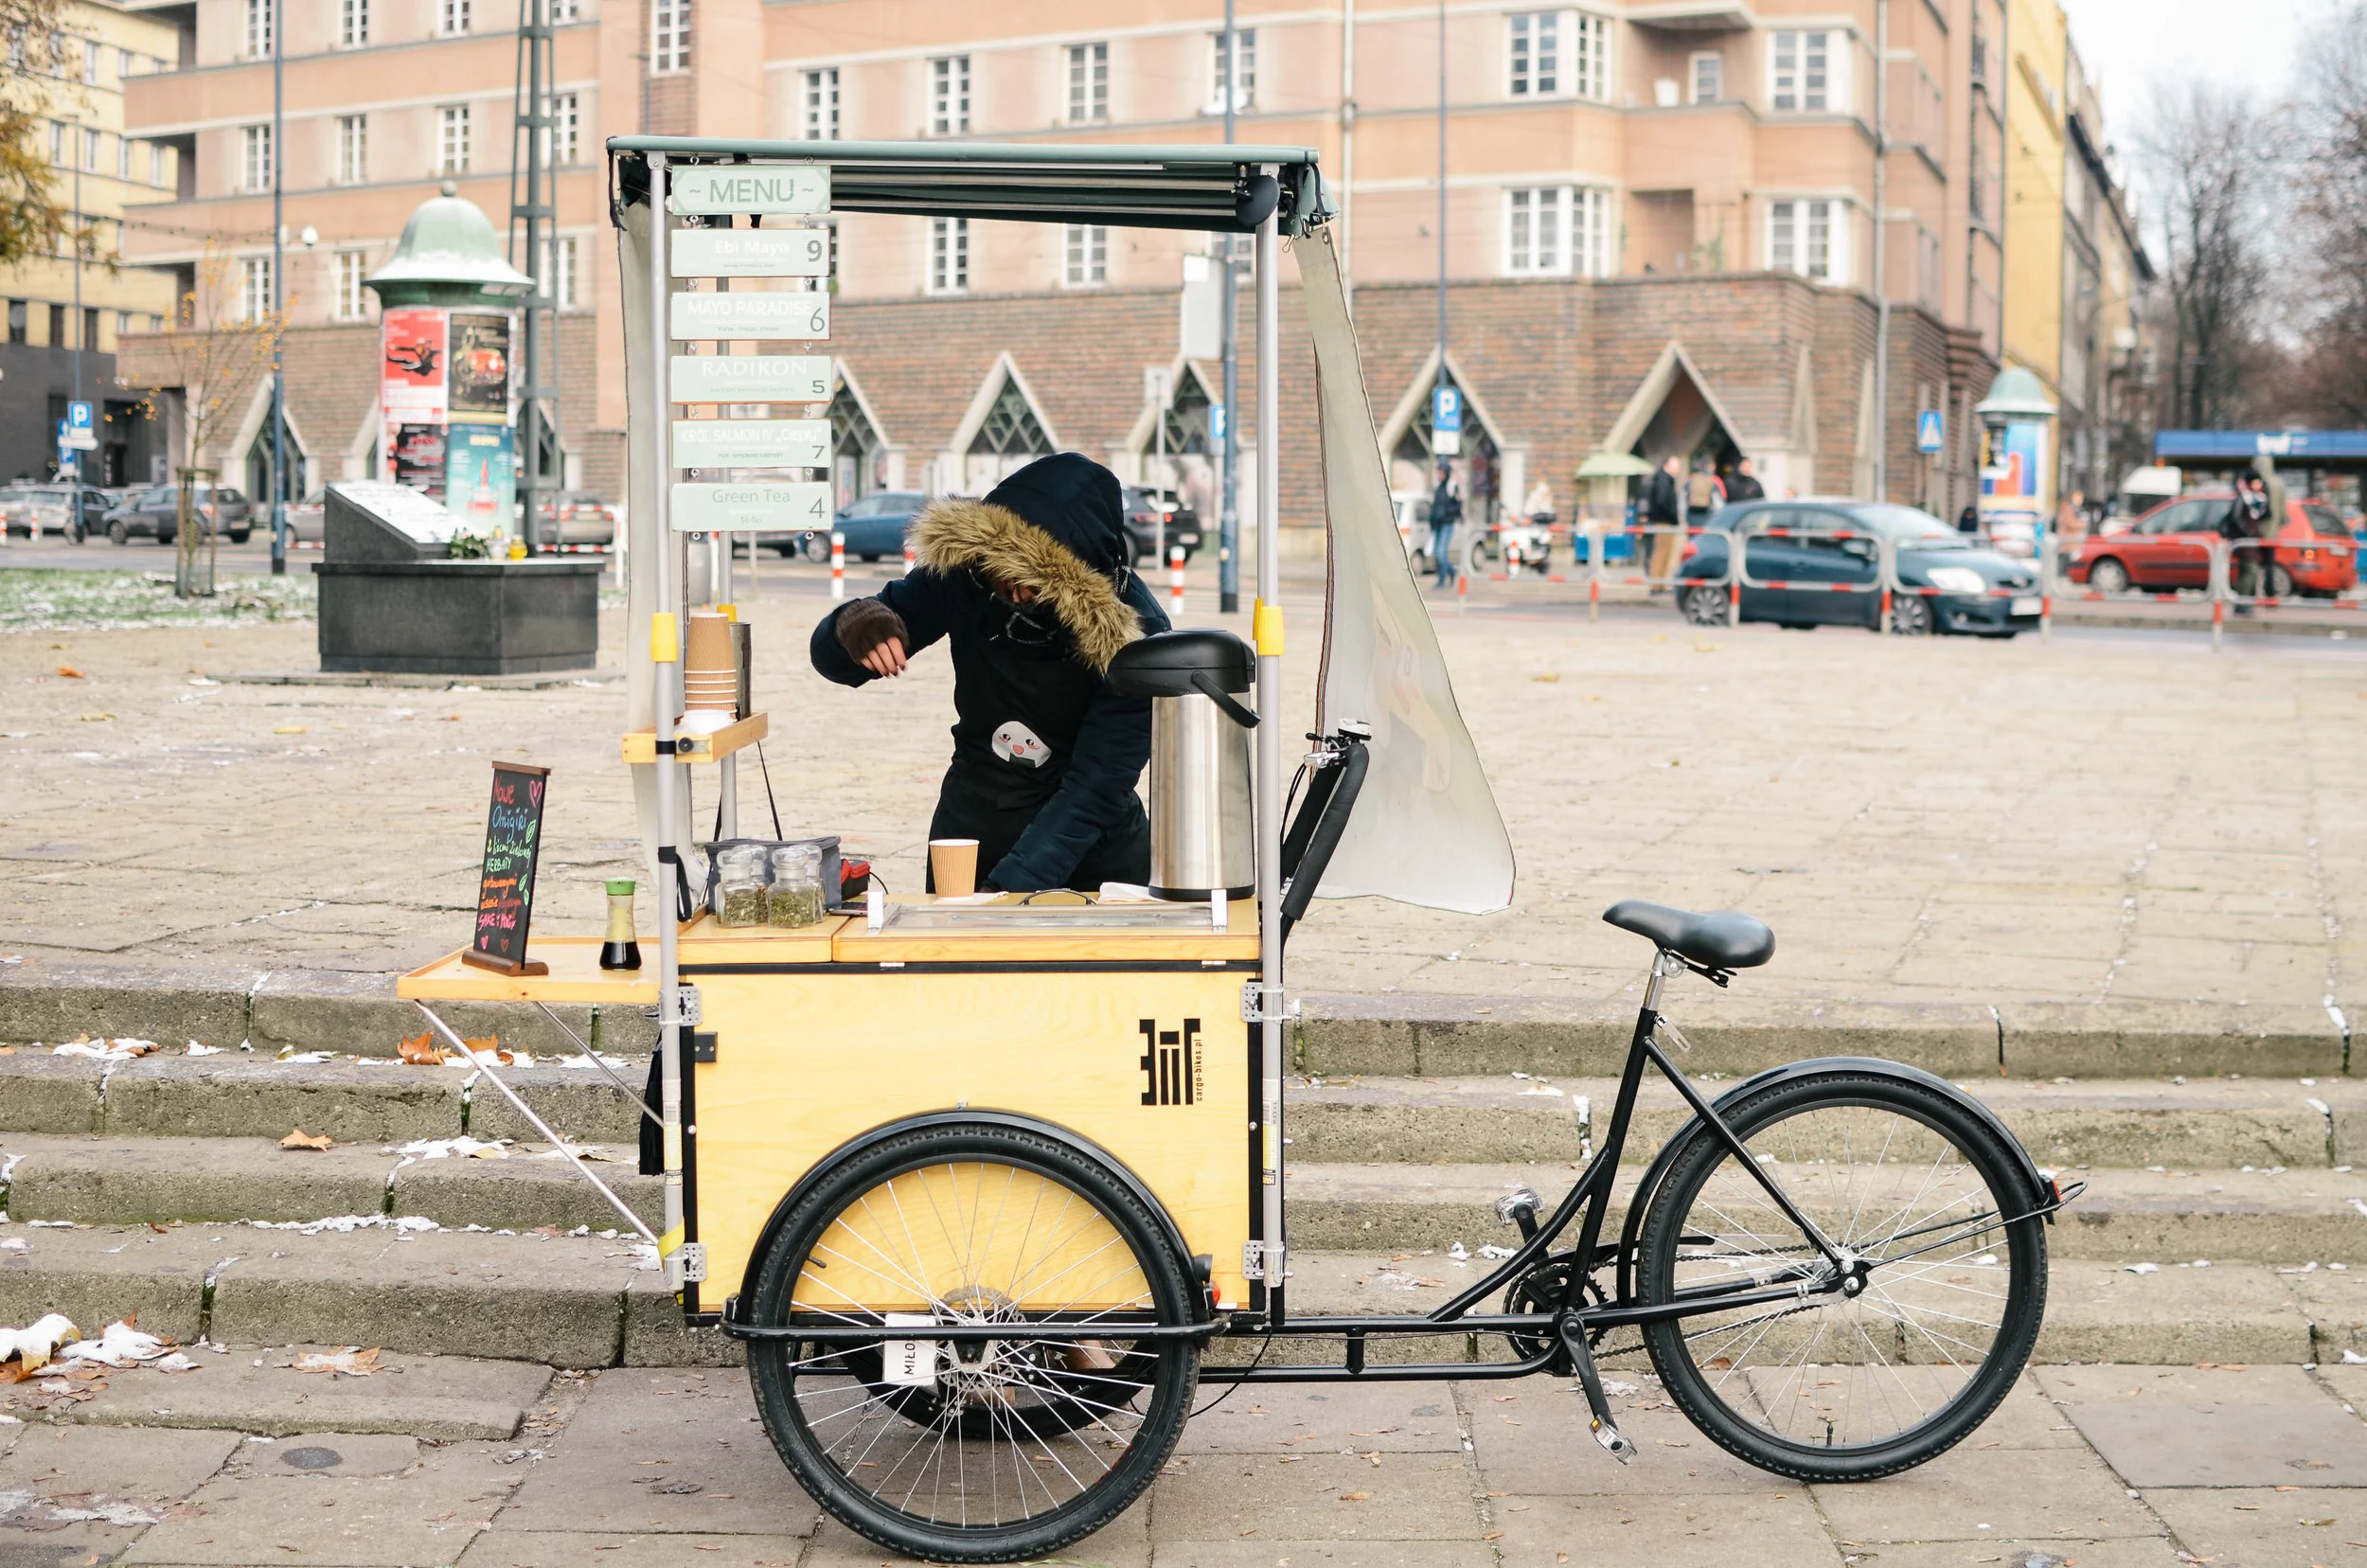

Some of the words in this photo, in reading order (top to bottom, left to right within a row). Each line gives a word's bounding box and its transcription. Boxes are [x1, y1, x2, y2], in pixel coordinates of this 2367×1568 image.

[710, 179, 794, 203] MENU
[715, 241, 739, 254] Ebi
[744, 241, 789, 258] Mayo
[807, 240, 823, 262] 9
[687, 300, 732, 315] MAYO
[737, 300, 812, 315] PARADISE
[810, 307, 826, 332] 6
[703, 361, 807, 377] RADIKON
[811, 380, 826, 394] 5
[74, 403, 88, 427] P
[1440, 389, 1456, 419] P
[713, 429, 760, 443] SALMON
[761, 429, 774, 442] IV
[811, 445, 826, 459] 7
[712, 489, 758, 503] Green
[763, 489, 791, 503] Tea
[809, 496, 826, 519] 4
[1194, 1039, 1203, 1101] cargo-bikes.pl
[904, 1342, 916, 1375] MIŁO
